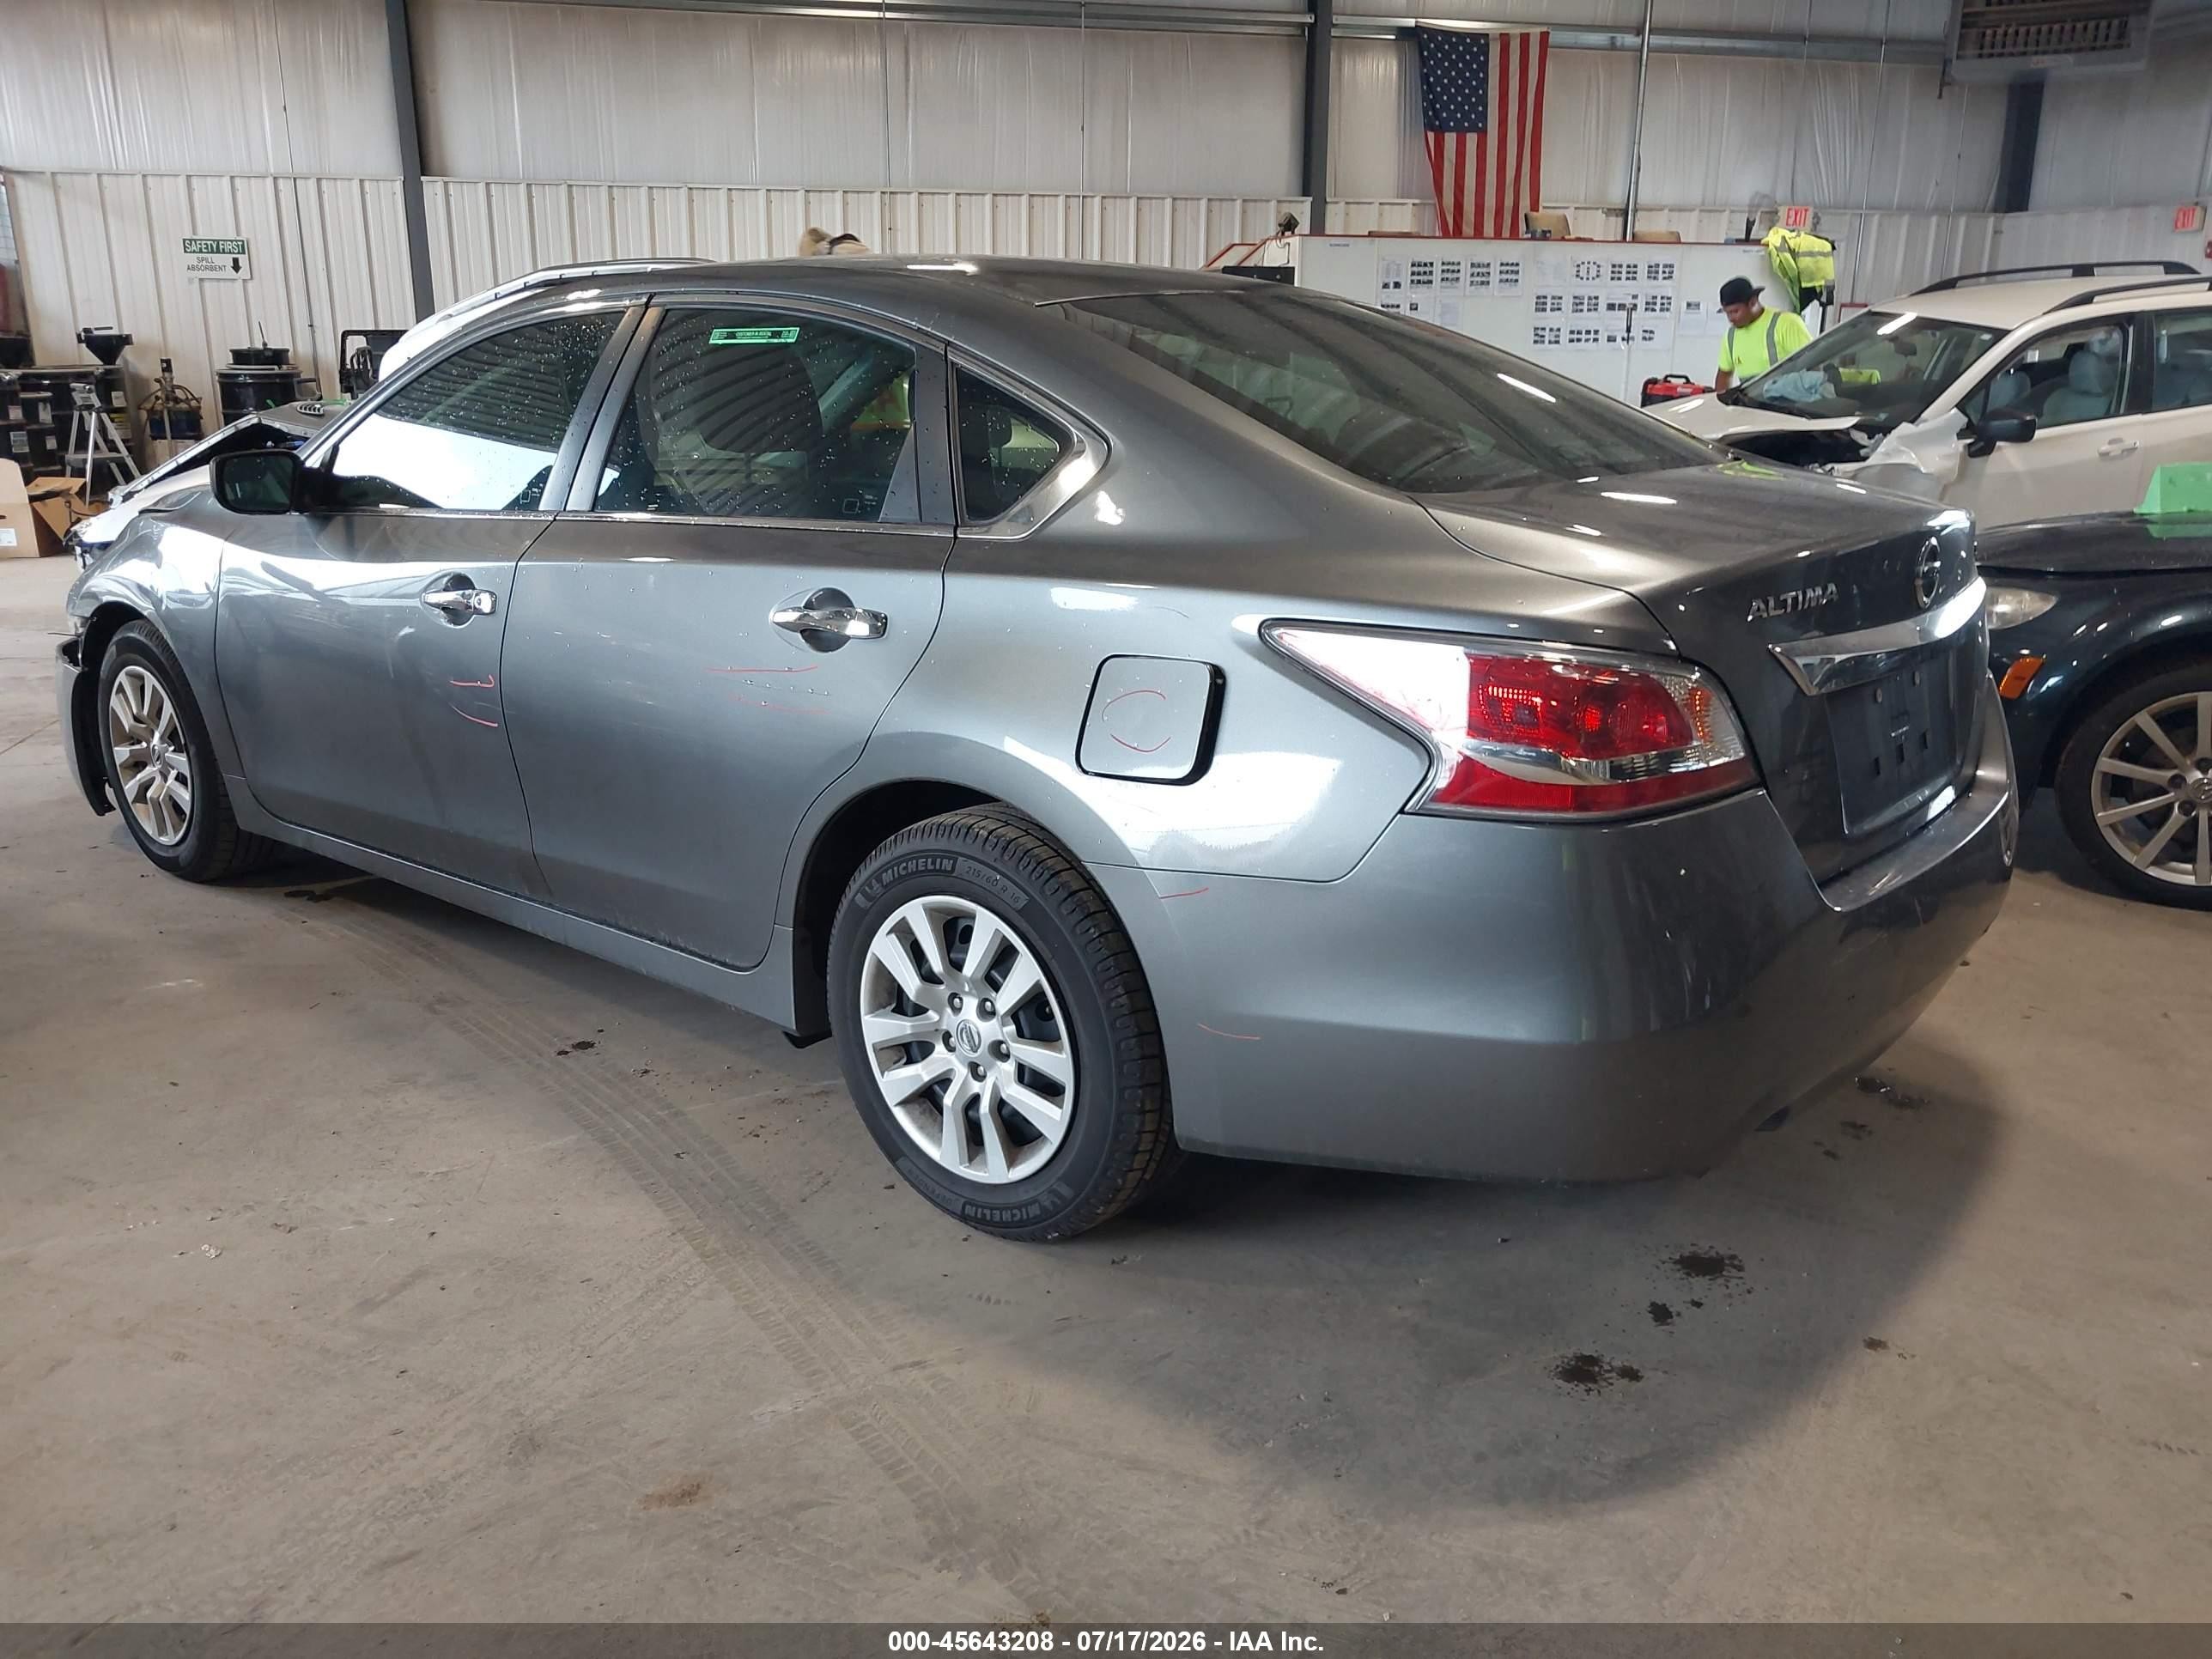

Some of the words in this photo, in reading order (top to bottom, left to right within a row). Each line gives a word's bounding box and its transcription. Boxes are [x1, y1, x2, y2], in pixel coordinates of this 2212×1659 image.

[1786, 207, 1809, 227] EXIT
[2174, 206, 2197, 229] EXIT
[185, 240, 217, 252] SAFETY
[219, 240, 243, 253] FIRST
[1747, 582, 1839, 622] ALTIMA
[882, 857, 955, 886] MICHELIN
[965, 866, 999, 888] 215/60
[1000, 884, 1008, 895] R
[1010, 892, 1020, 903] 16
[963, 1201, 1041, 1223] MICHELIN
